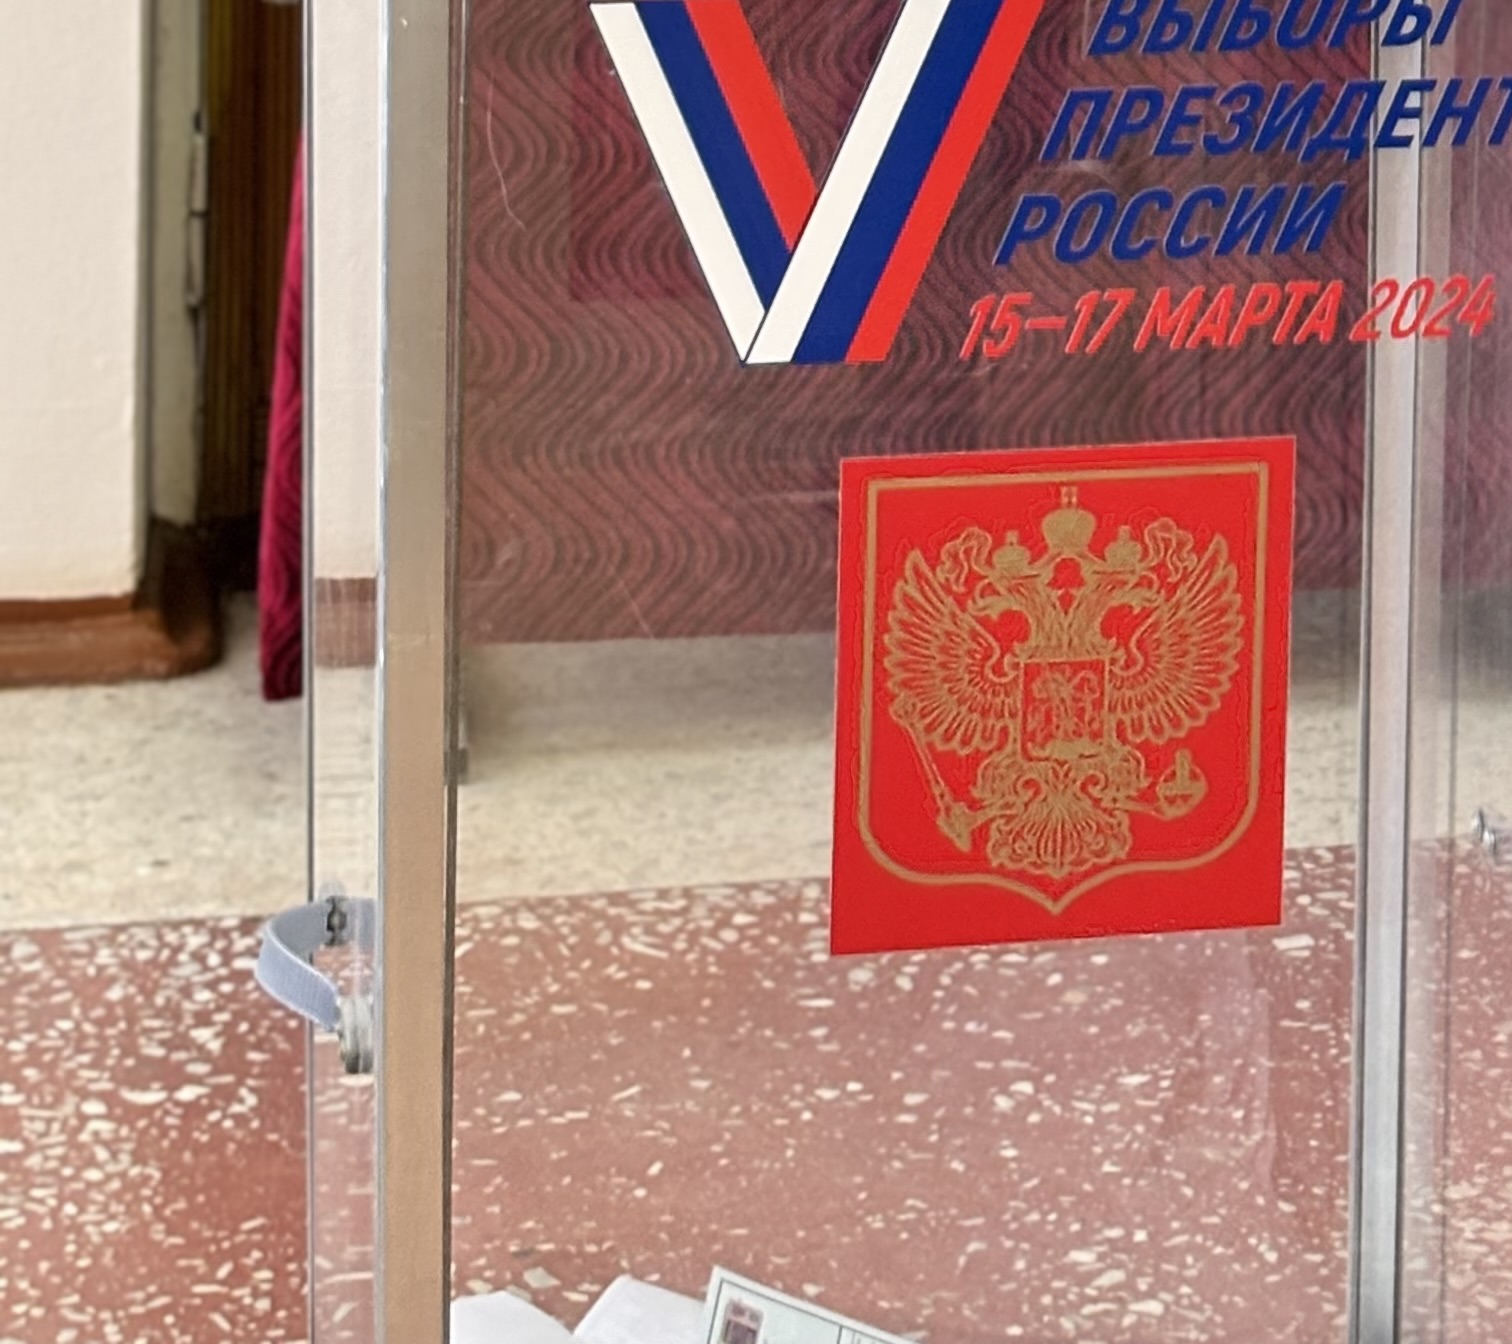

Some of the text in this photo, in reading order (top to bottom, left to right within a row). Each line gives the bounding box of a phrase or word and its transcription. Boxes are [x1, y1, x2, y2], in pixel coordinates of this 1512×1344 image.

[993, 182, 1349, 266] РОССИИ
[1132, 279, 1349, 353] МАРТА
[1349, 272, 1497, 342] 2024
